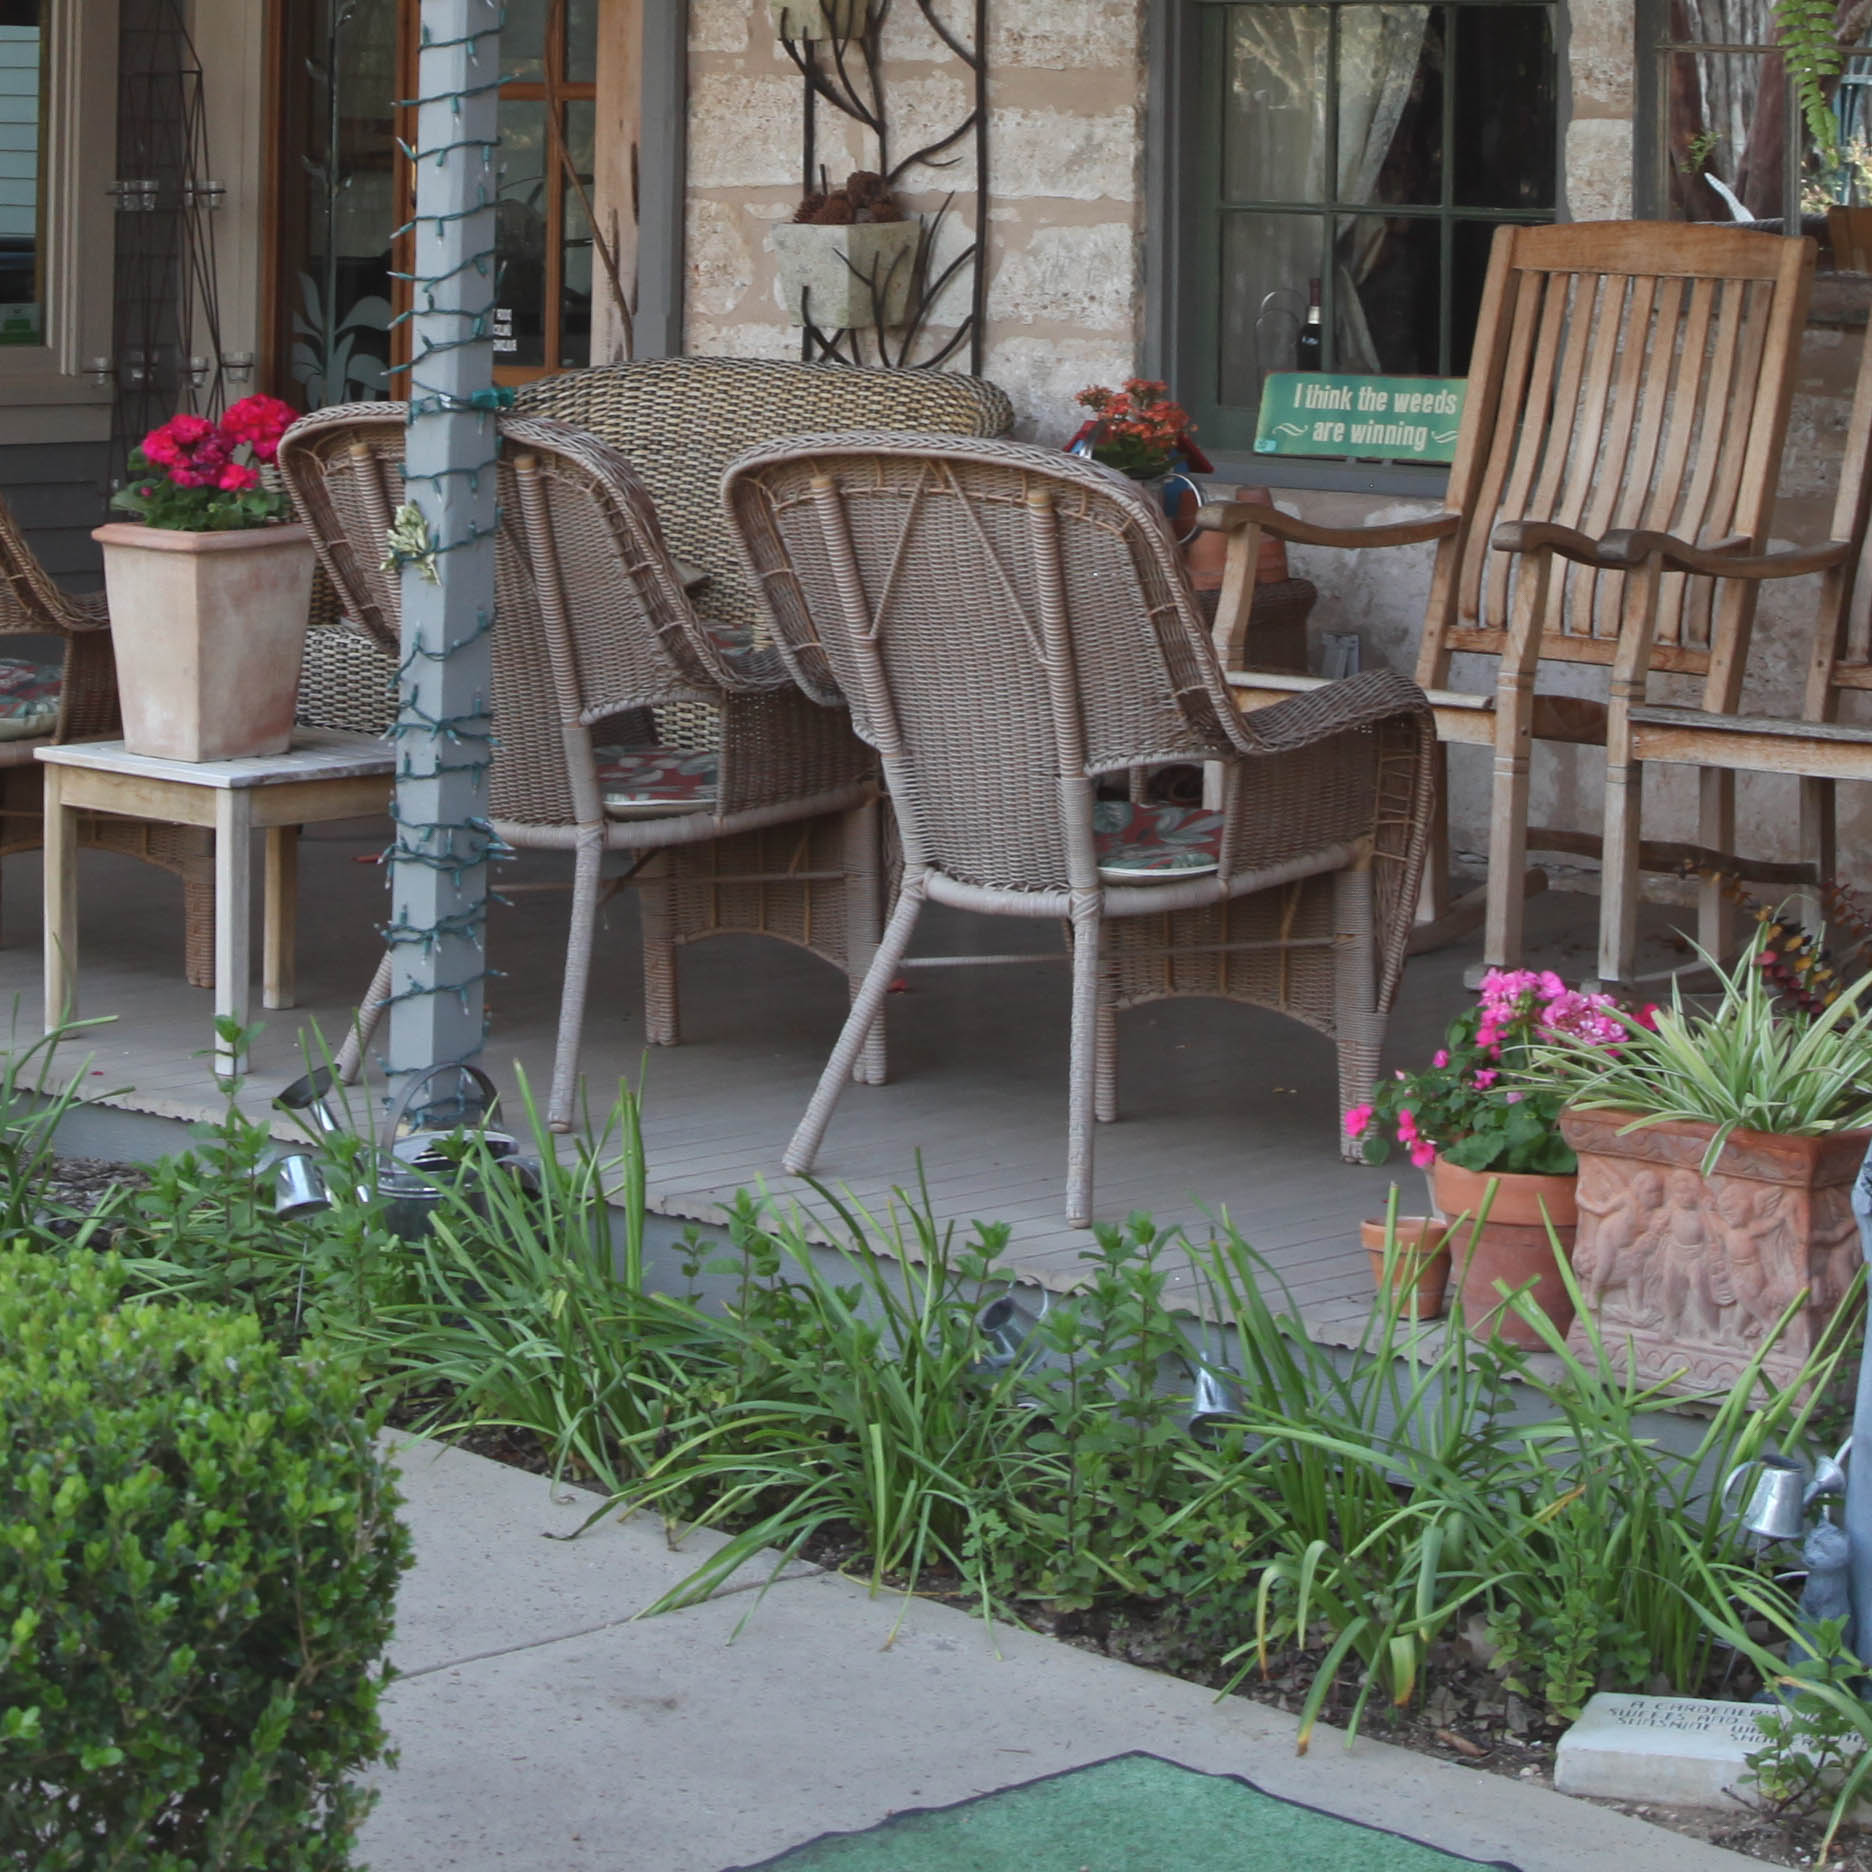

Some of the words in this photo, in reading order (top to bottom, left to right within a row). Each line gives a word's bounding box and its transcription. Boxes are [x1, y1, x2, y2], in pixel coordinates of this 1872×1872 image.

[1293, 383, 1303, 409] I
[1306, 384, 1353, 412] think
[1358, 386, 1388, 412] the
[1393, 388, 1457, 415] weeds
[1312, 420, 1345, 442] are
[1350, 420, 1428, 452] winning
